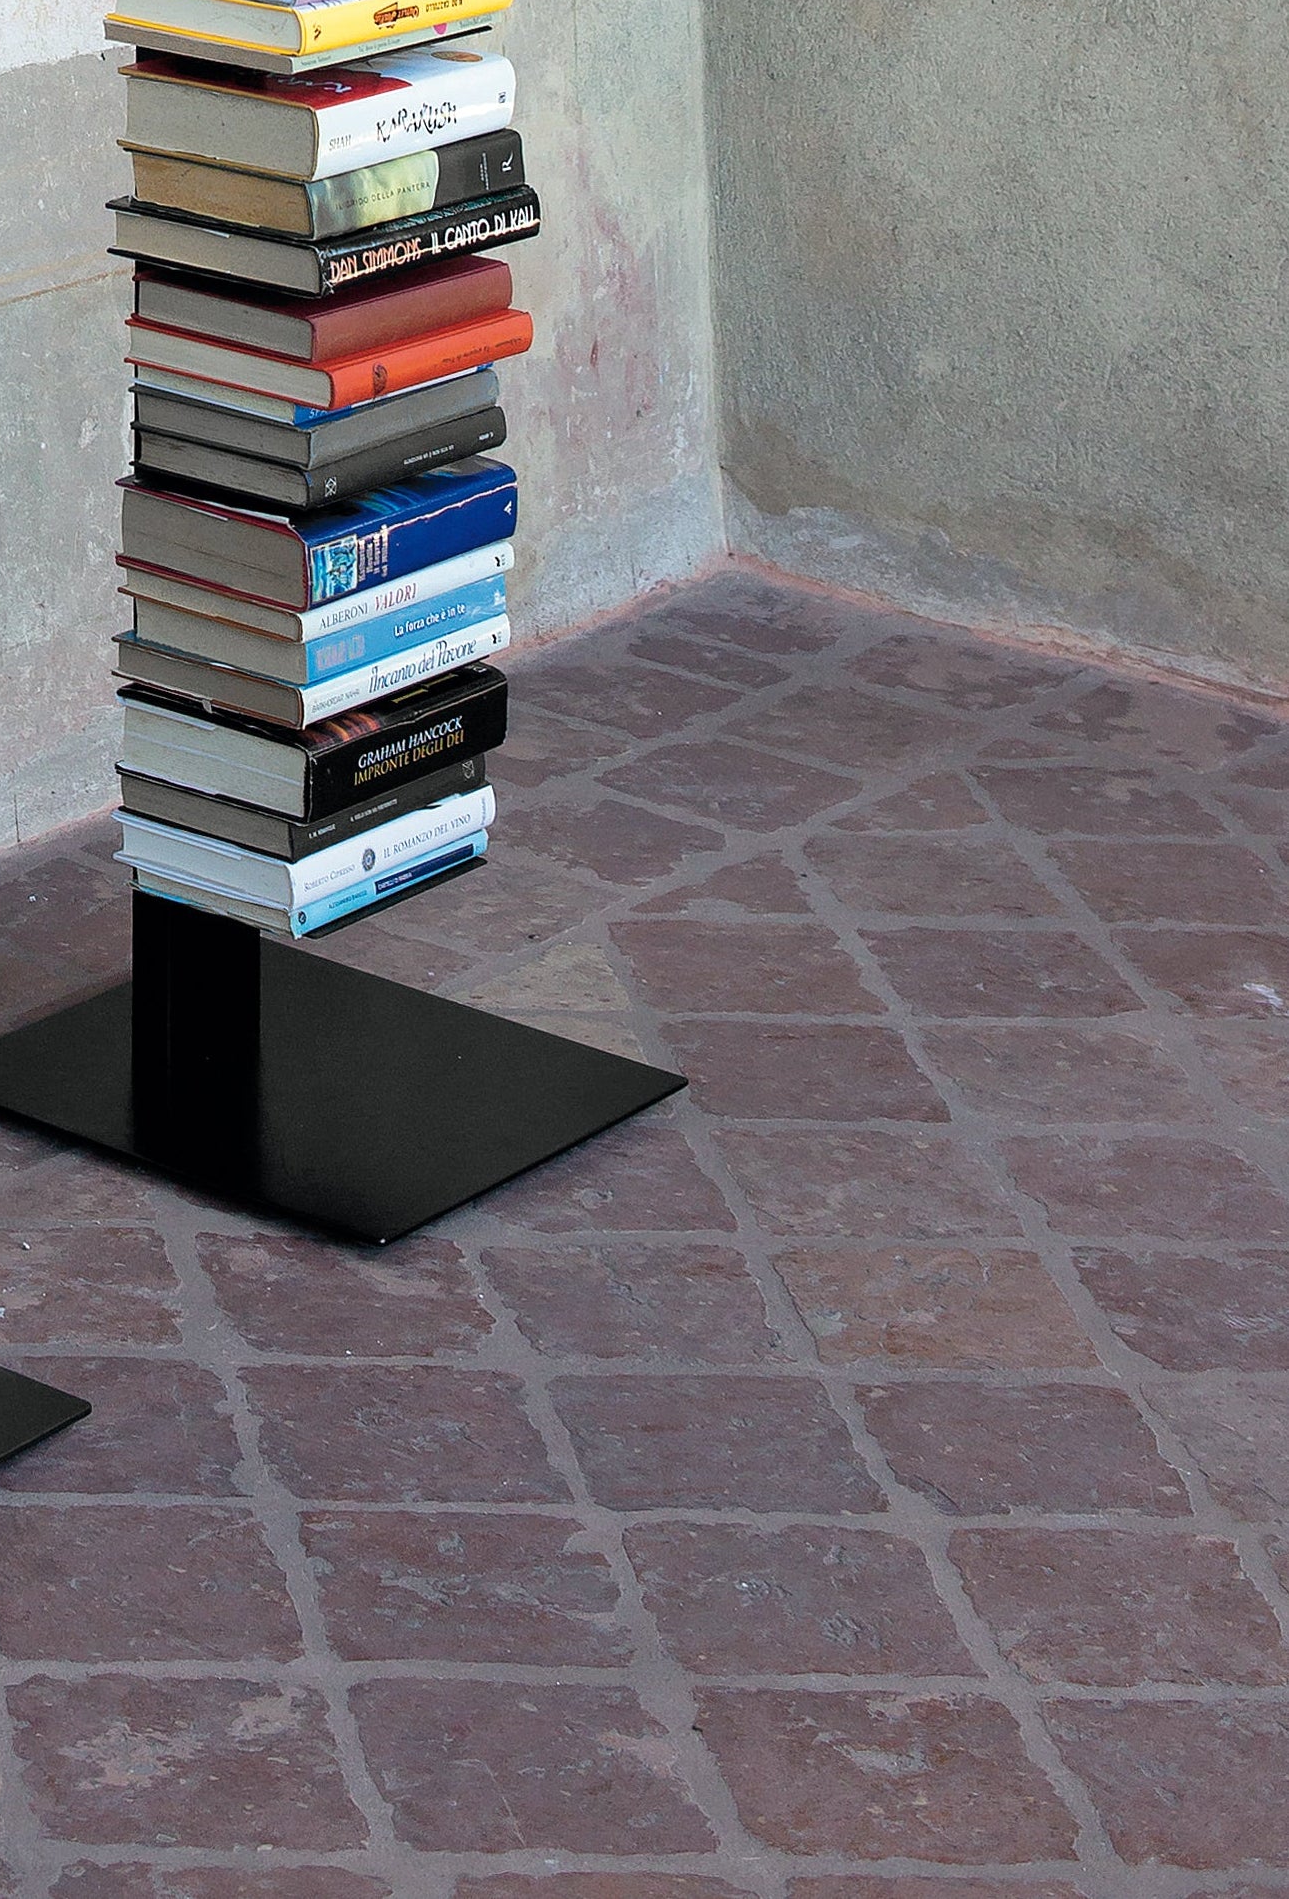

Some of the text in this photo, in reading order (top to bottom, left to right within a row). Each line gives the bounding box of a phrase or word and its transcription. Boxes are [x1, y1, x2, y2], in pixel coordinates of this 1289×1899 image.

[329, 102, 458, 151] SHAH KARAKUSH
[371, 190, 394, 202] DELLA
[397, 182, 430, 195] PANTERA
[329, 204, 535, 283] DAN SIMMONS IL CANTO DI KALI
[319, 583, 417, 630] ALBERONI VALORI
[394, 602, 467, 637] La forza che è in te
[417, 649, 435, 675] del
[436, 639, 477, 668] Pavone
[353, 730, 465, 786] IMPRONTE DEGLI DEI
[357, 714, 464, 769] GRAHAM HANCOCK
[383, 847, 391, 859] IL
[393, 829, 433, 855] ROMANZO
[434, 822, 448, 837] DEL
[450, 813, 471, 829] VINO
